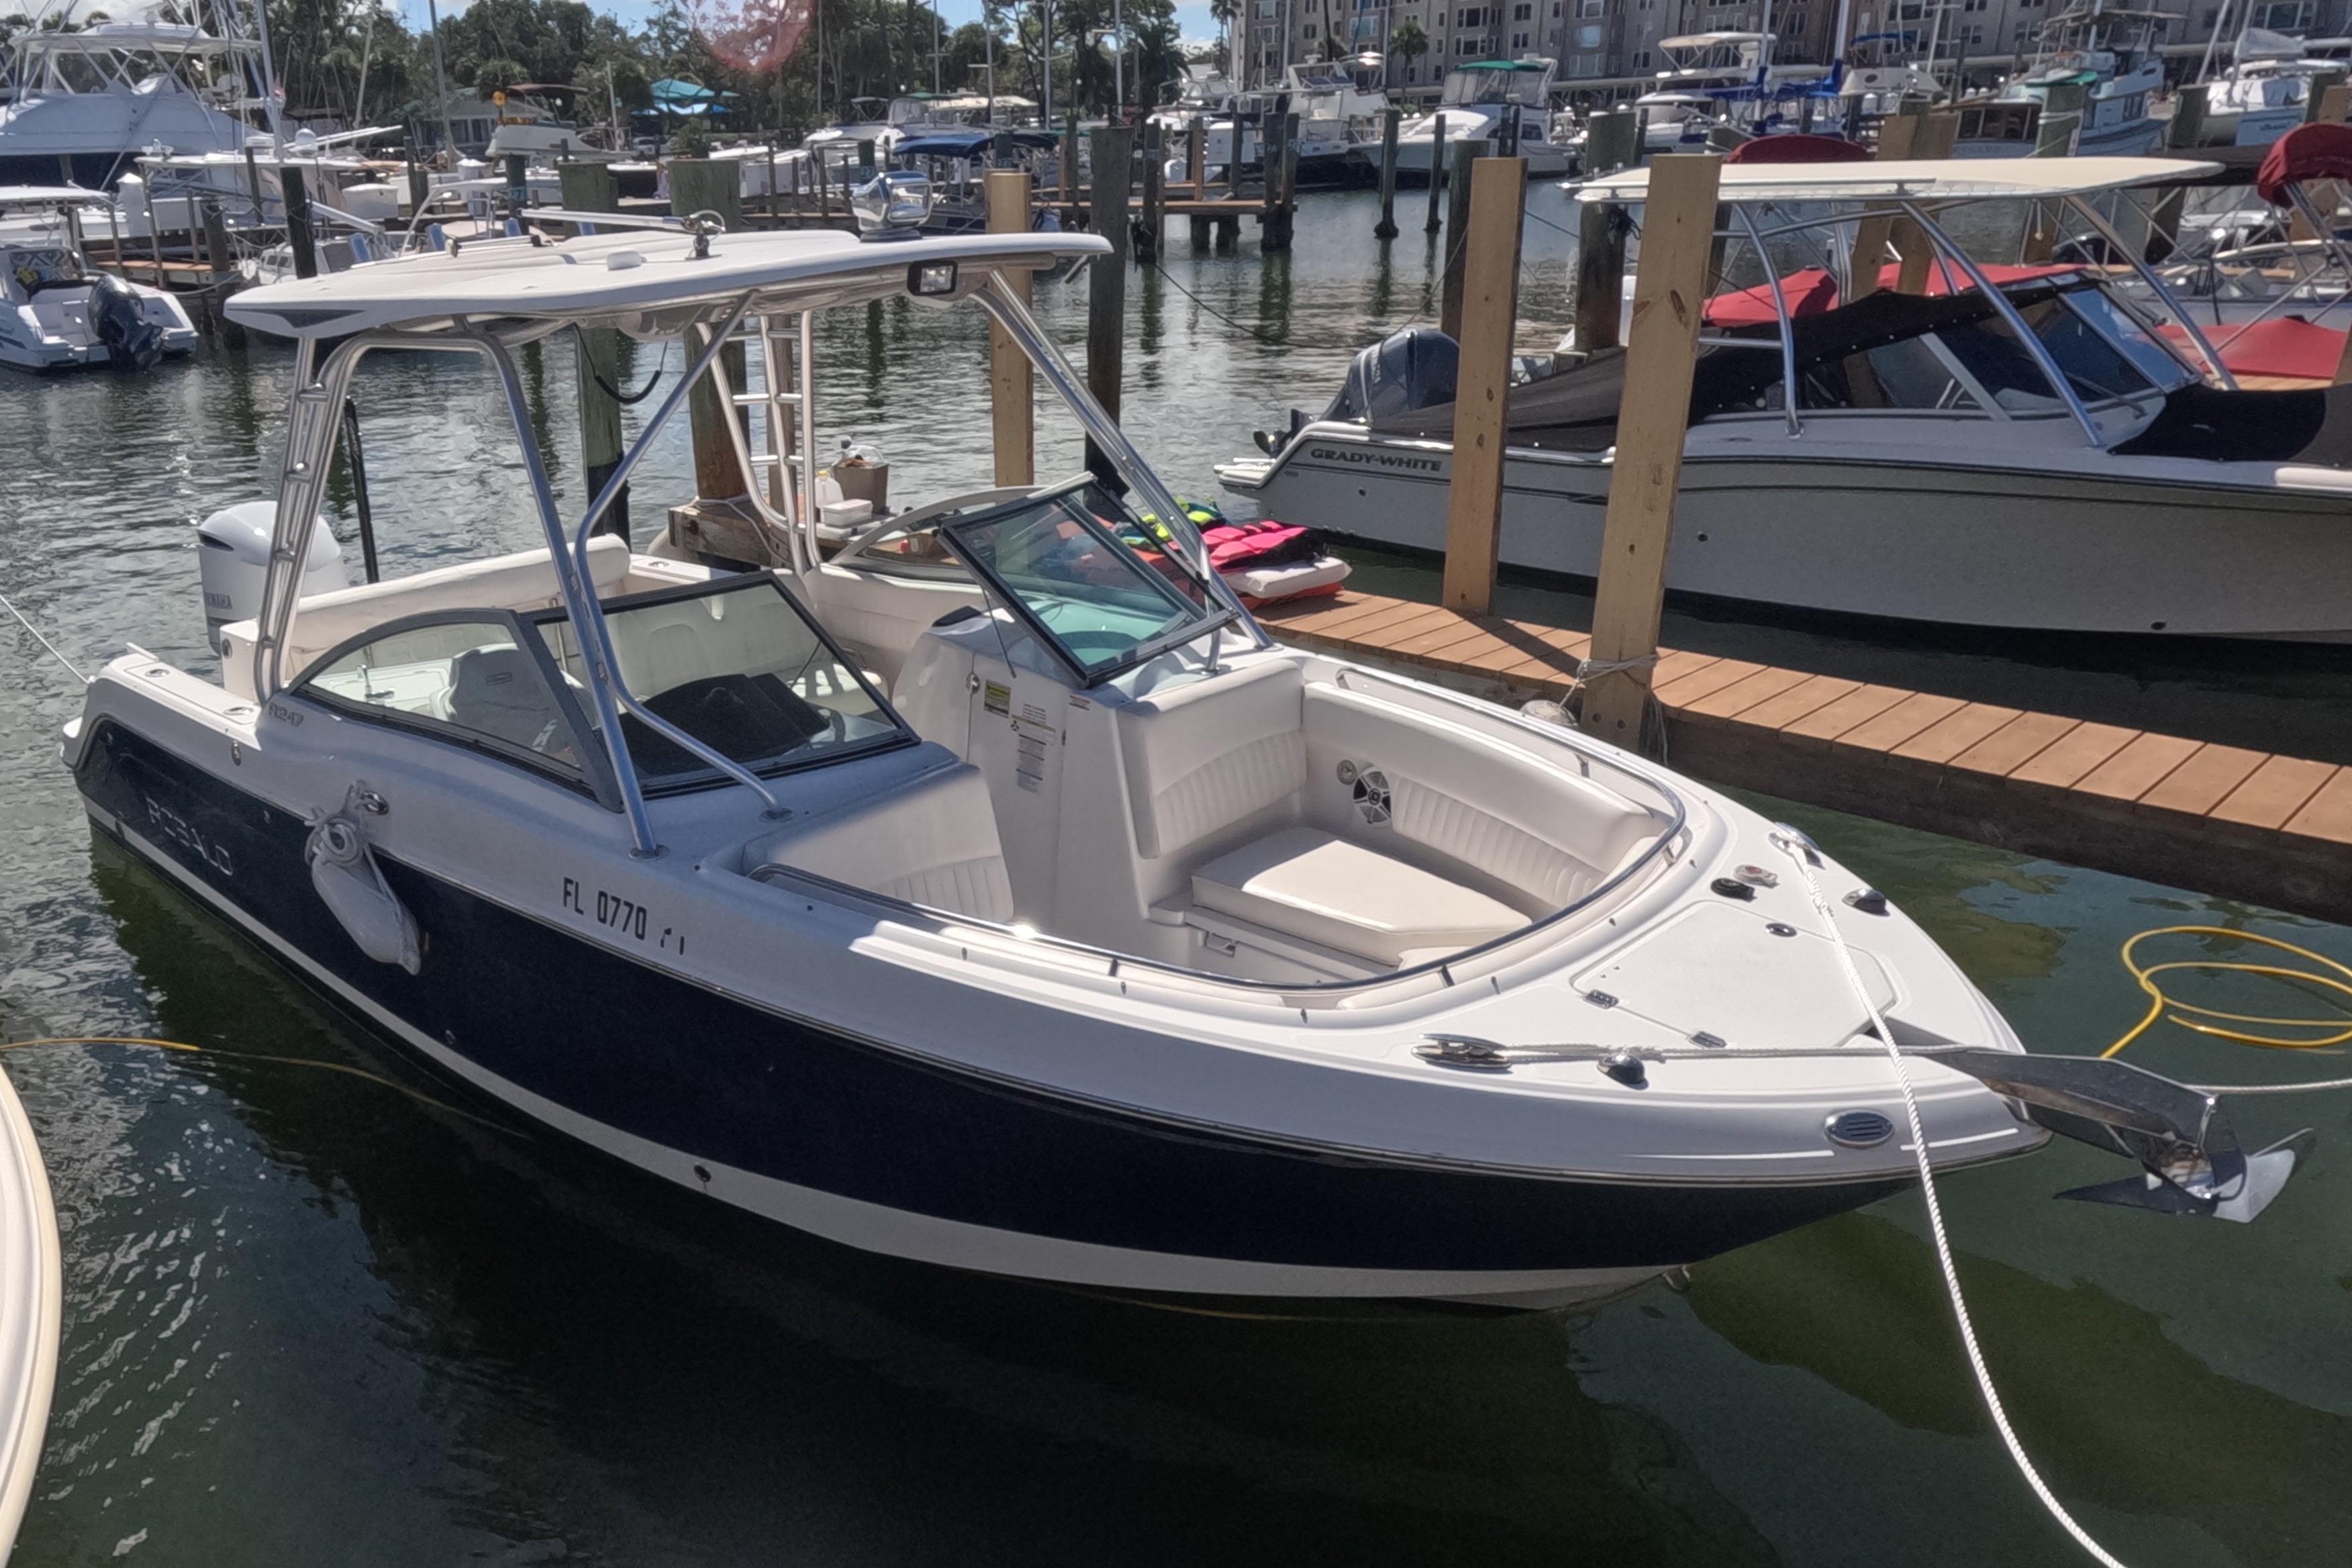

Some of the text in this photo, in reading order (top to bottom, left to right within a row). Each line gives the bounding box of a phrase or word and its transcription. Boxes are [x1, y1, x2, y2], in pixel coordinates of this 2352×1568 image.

[1310, 448, 1442, 472] GRADY-WHITE
[563, 876, 647, 940] FL 0770
